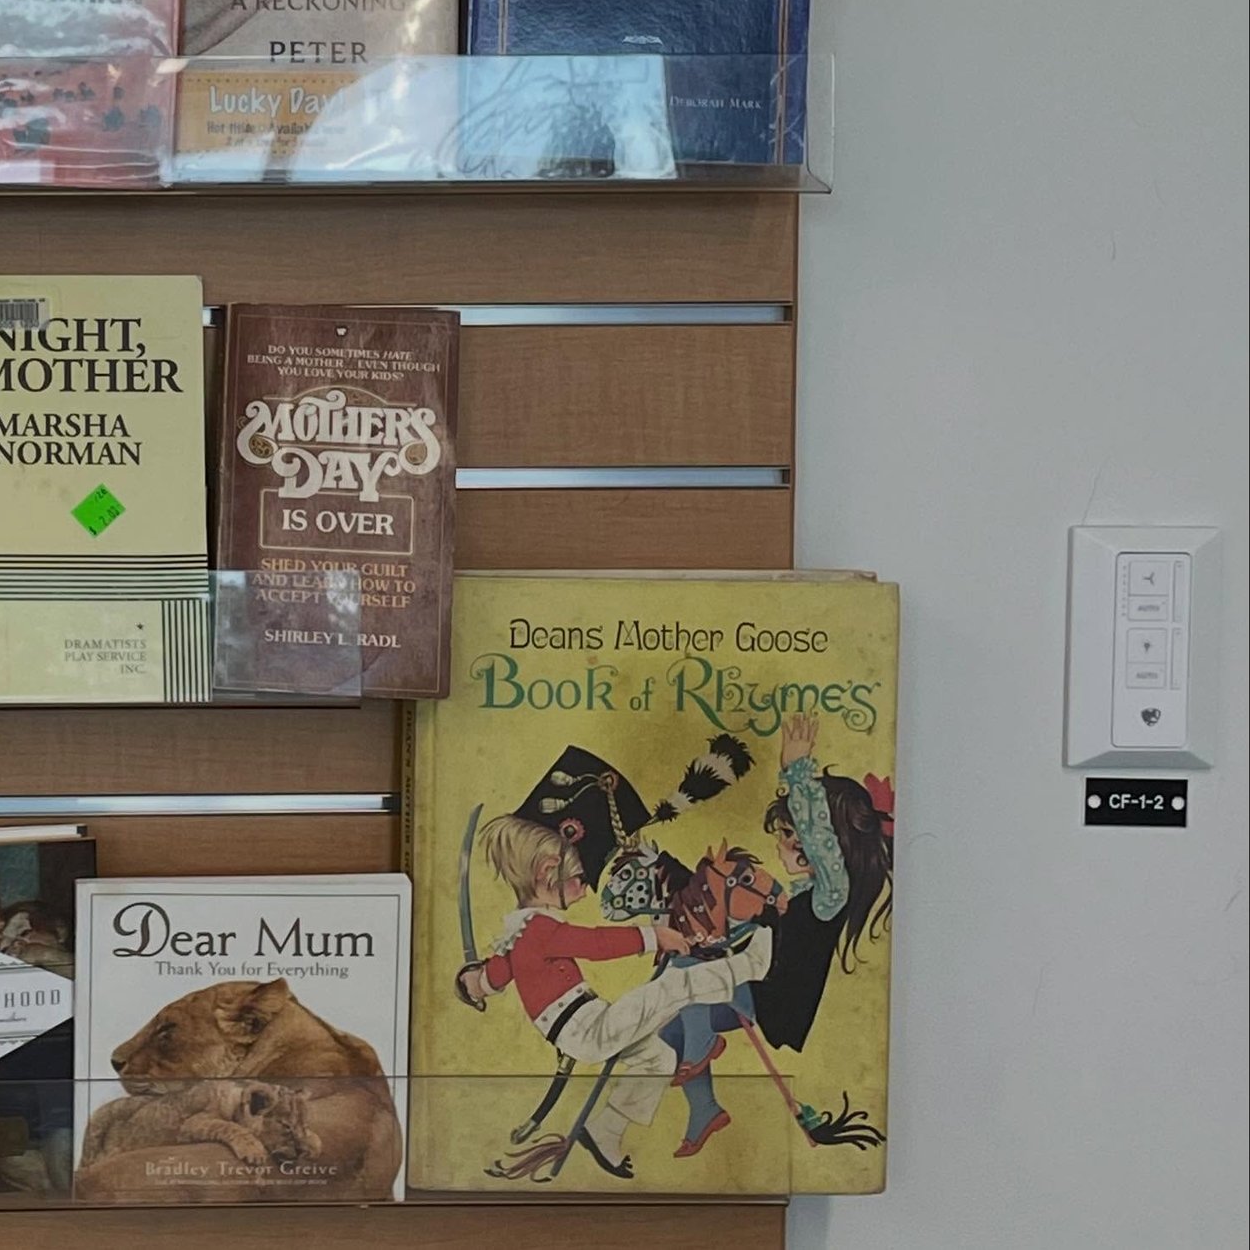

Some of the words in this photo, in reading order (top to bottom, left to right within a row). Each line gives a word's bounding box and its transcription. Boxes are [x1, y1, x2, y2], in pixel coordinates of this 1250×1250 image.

[270, 41, 368, 64] PETER
[209, 85, 282, 118] Lucky
[670, 95, 724, 108] DEBORAH
[730, 98, 762, 109] MARK
[268, 345, 285, 355] DO
[289, 346, 313, 355] YOU
[315, 348, 380, 359] SOMETIMES
[382, 351, 413, 361] HATE
[247, 354, 282, 365] BEING
[358, 359, 388, 370] EVEN
[391, 361, 440, 373] THOUGH
[277, 367, 302, 376] YOU
[304, 368, 335, 378] LOVE
[336, 369, 369, 379] YOUR
[371, 370, 405, 381] KIDS?
[271, 447, 402, 502] DAY
[282, 509, 307, 530] IS
[316, 511, 395, 535] OVER
[261, 558, 306, 573] SHED
[311, 560, 357, 574] YOUR
[361, 563, 408, 578] GUILT
[252, 573, 287, 587] AND
[394, 580, 416, 594] TO
[255, 588, 322, 604] ACCEPT
[64, 639, 147, 650] DRAMATISTS
[264, 629, 334, 645] SHIRLEY
[356, 633, 401, 648] RADL
[510, 618, 603, 651] Deans
[614, 620, 723, 652] Mother
[736, 622, 829, 654] Goose
[64, 652, 93, 662] PLAY
[96, 652, 147, 662] SERVICE
[120, 664, 147, 674] INC.
[470, 653, 619, 711] Book
[629, 677, 654, 712] of
[667, 653, 882, 737] Rhymes
[1109, 793, 1164, 810] CF-1-2
[112, 902, 236, 958] Dear
[254, 917, 375, 957] Mum
[155, 961, 203, 976] Thank
[208, 962, 236, 976] You
[241, 962, 261, 976] for
[267, 962, 349, 979] Everything
[145, 1160, 210, 1178] Bradley
[217, 1160, 272, 1177] Trevor
[280, 1160, 338, 1176] Greive
